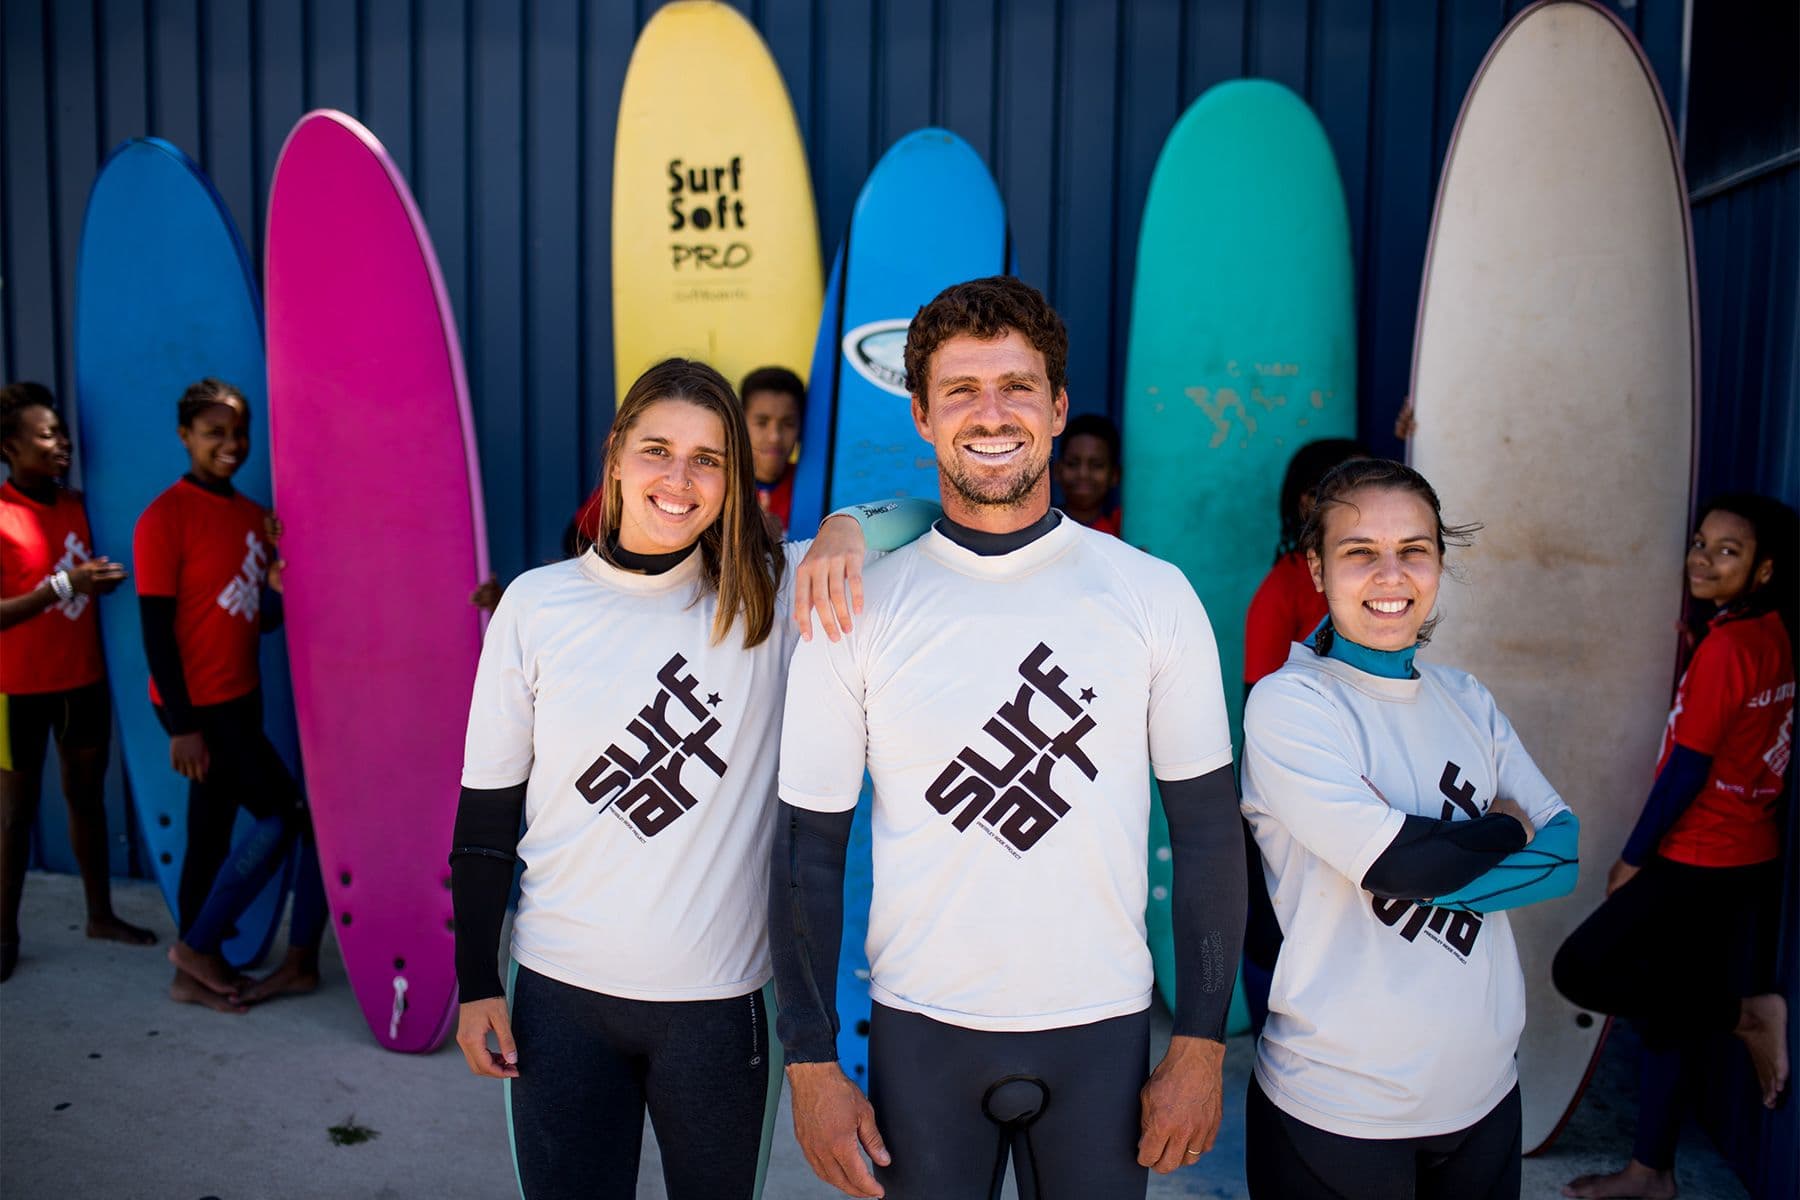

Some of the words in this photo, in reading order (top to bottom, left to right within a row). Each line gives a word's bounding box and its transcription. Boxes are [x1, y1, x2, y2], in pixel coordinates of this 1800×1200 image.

[669, 156, 742, 194] Surf
[669, 195, 745, 231] Soft
[671, 242, 752, 272] PRO
[925, 641, 1085, 833] surf
[982, 714, 1099, 852] art
